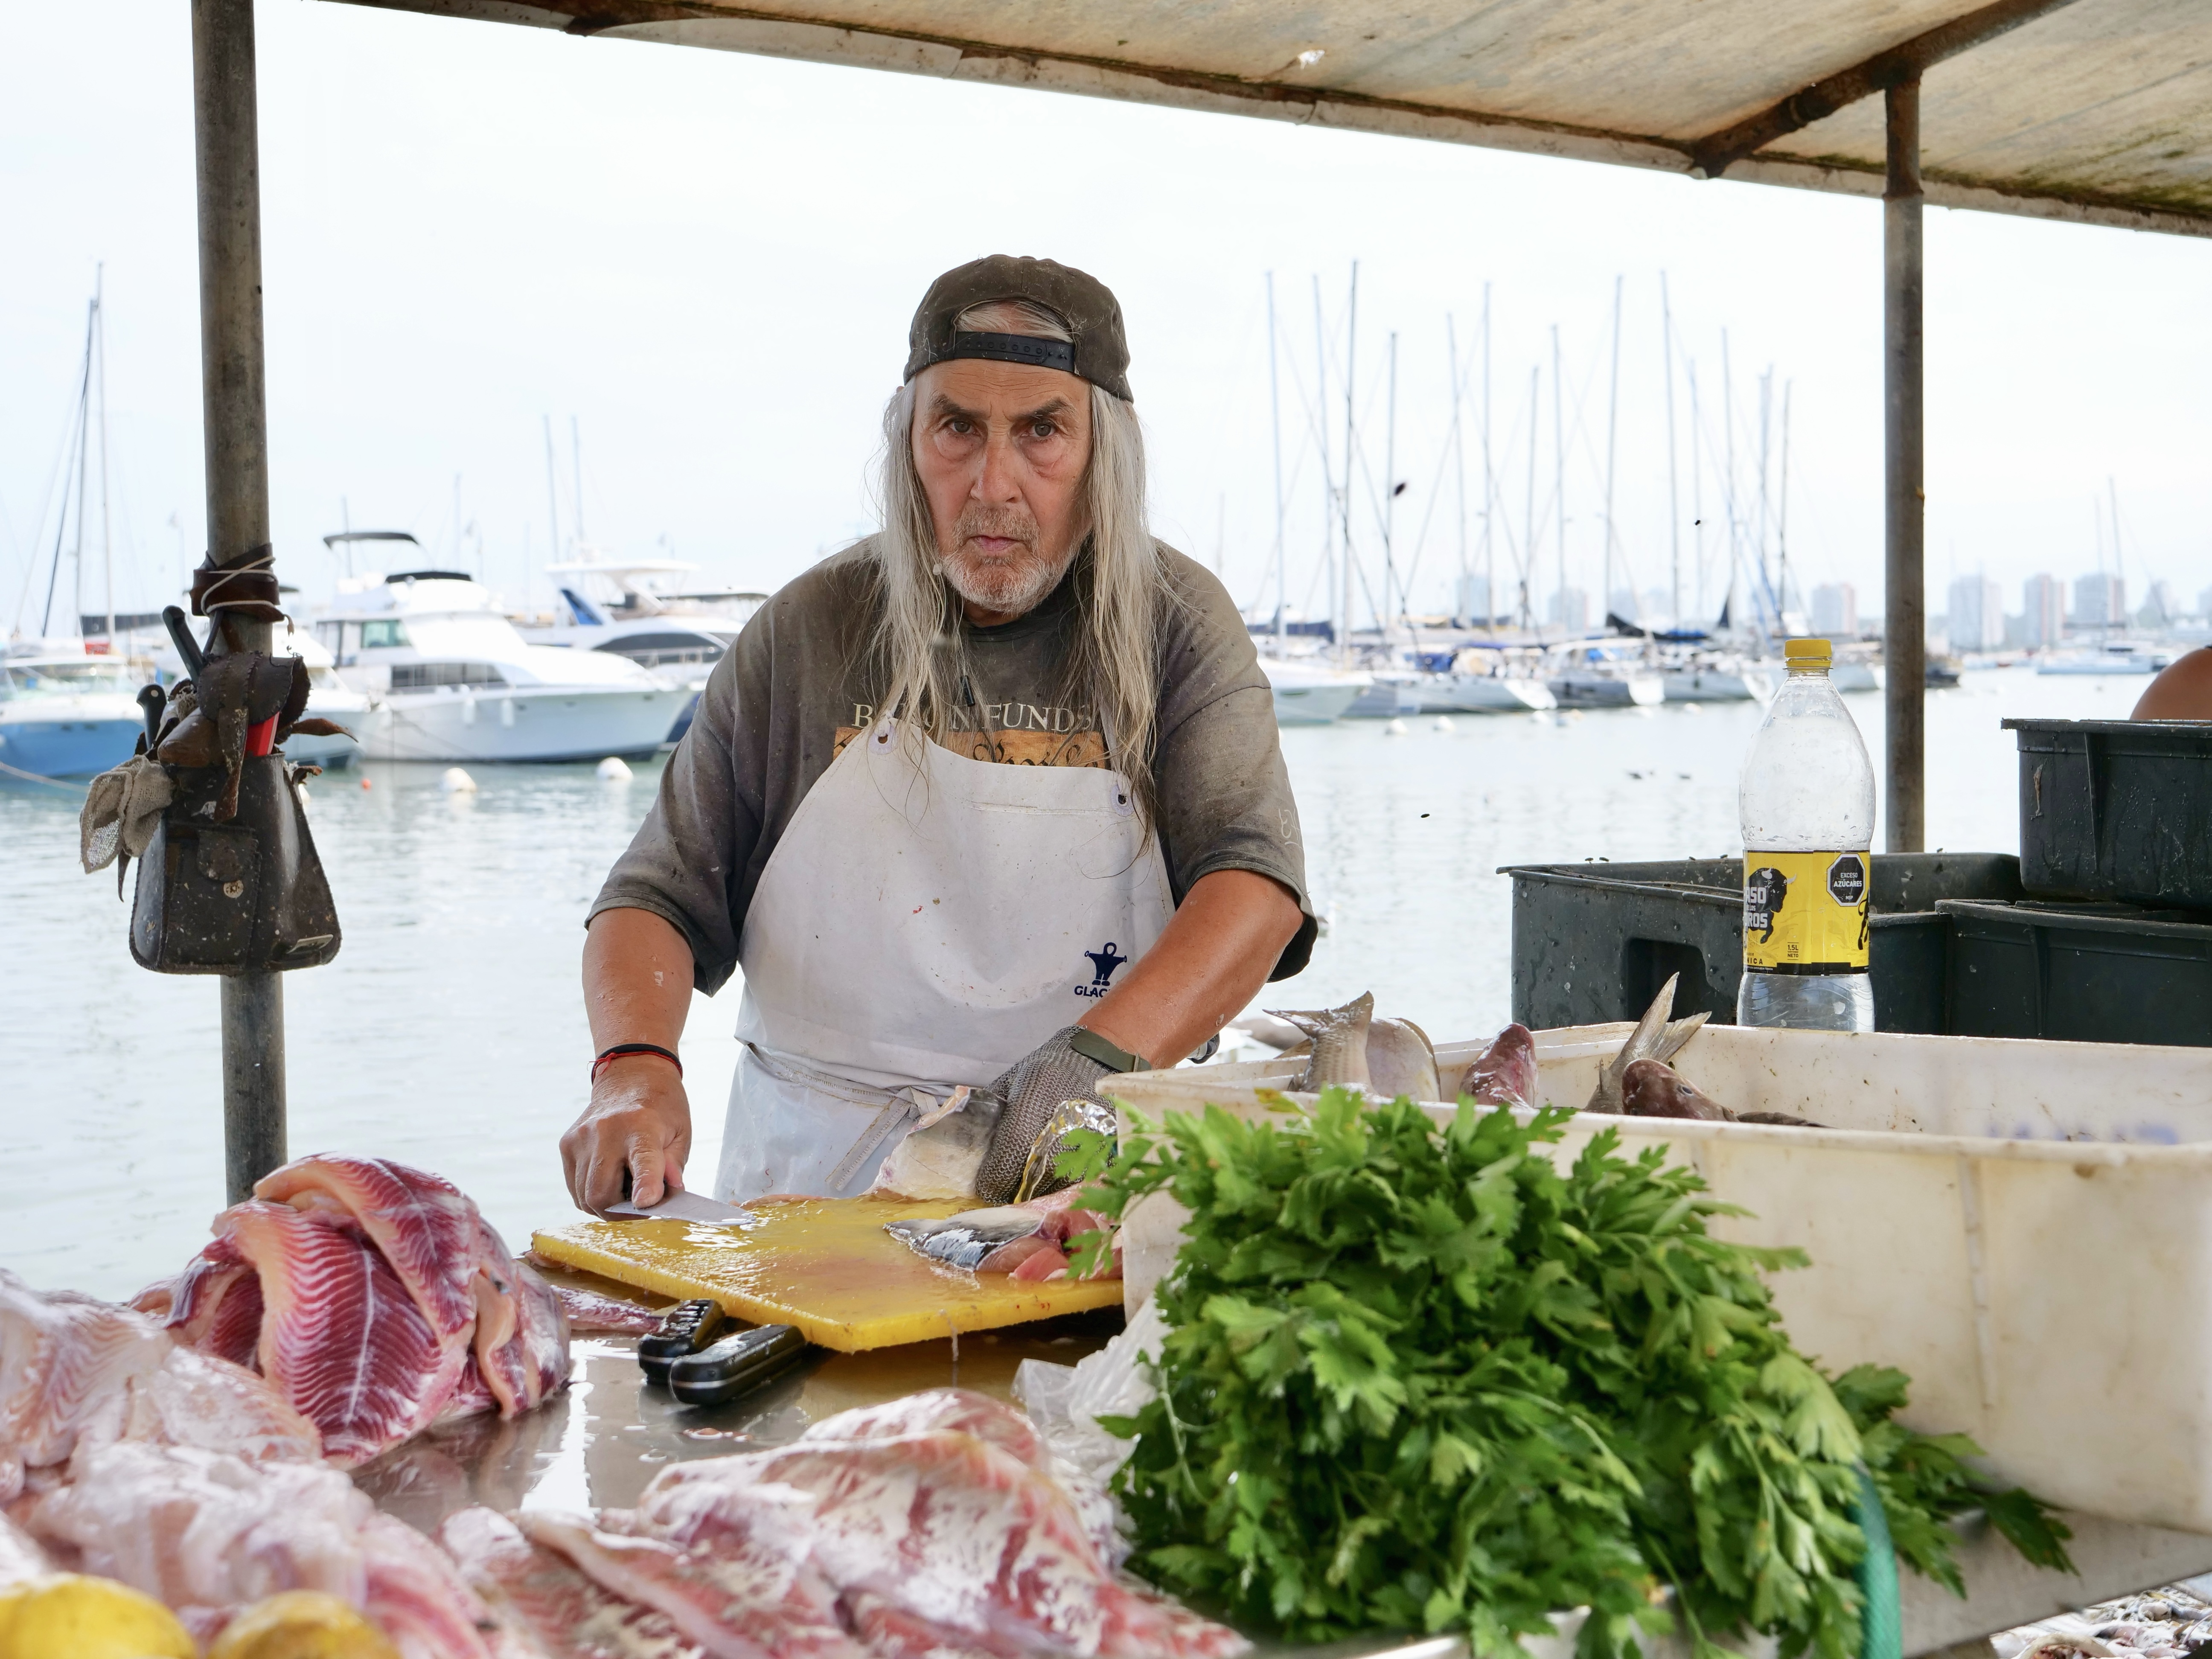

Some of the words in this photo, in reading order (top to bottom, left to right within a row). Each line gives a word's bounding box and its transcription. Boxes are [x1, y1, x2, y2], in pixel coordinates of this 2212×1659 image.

[982, 703, 1091, 732] FUNDS
[1834, 879, 1862, 888] AZÚCARES
[1744, 912, 1768, 928] OROS
[1074, 985, 1111, 998] GLAC
